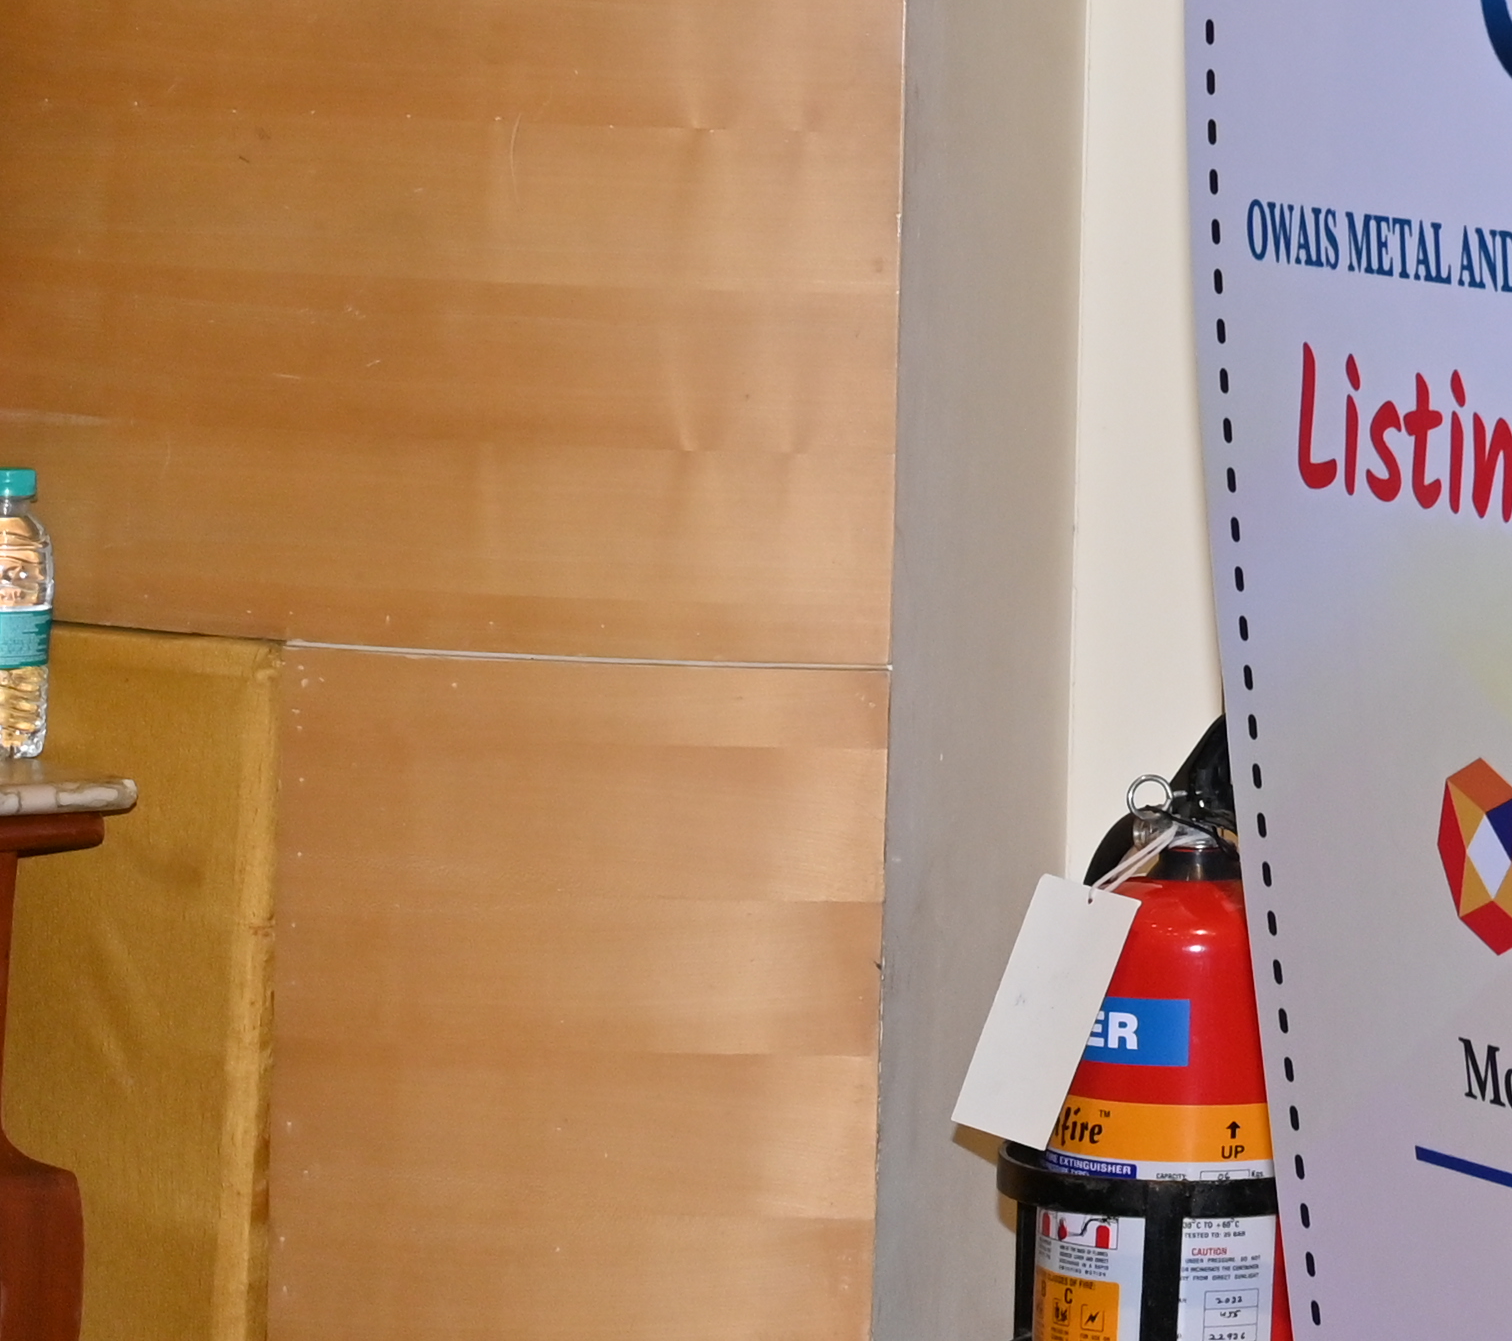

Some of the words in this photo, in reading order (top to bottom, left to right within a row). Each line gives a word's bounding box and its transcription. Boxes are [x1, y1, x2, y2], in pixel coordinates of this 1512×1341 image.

[1247, 199, 1339, 270] OWAIS
[1346, 212, 1451, 284] METAL
[1221, 1145, 1245, 1159] UP
[1059, 1156, 1132, 1175] EXTINGUISHER
[1191, 1247, 1227, 1256] CAUTION
[1064, 1288, 1073, 1305] C
